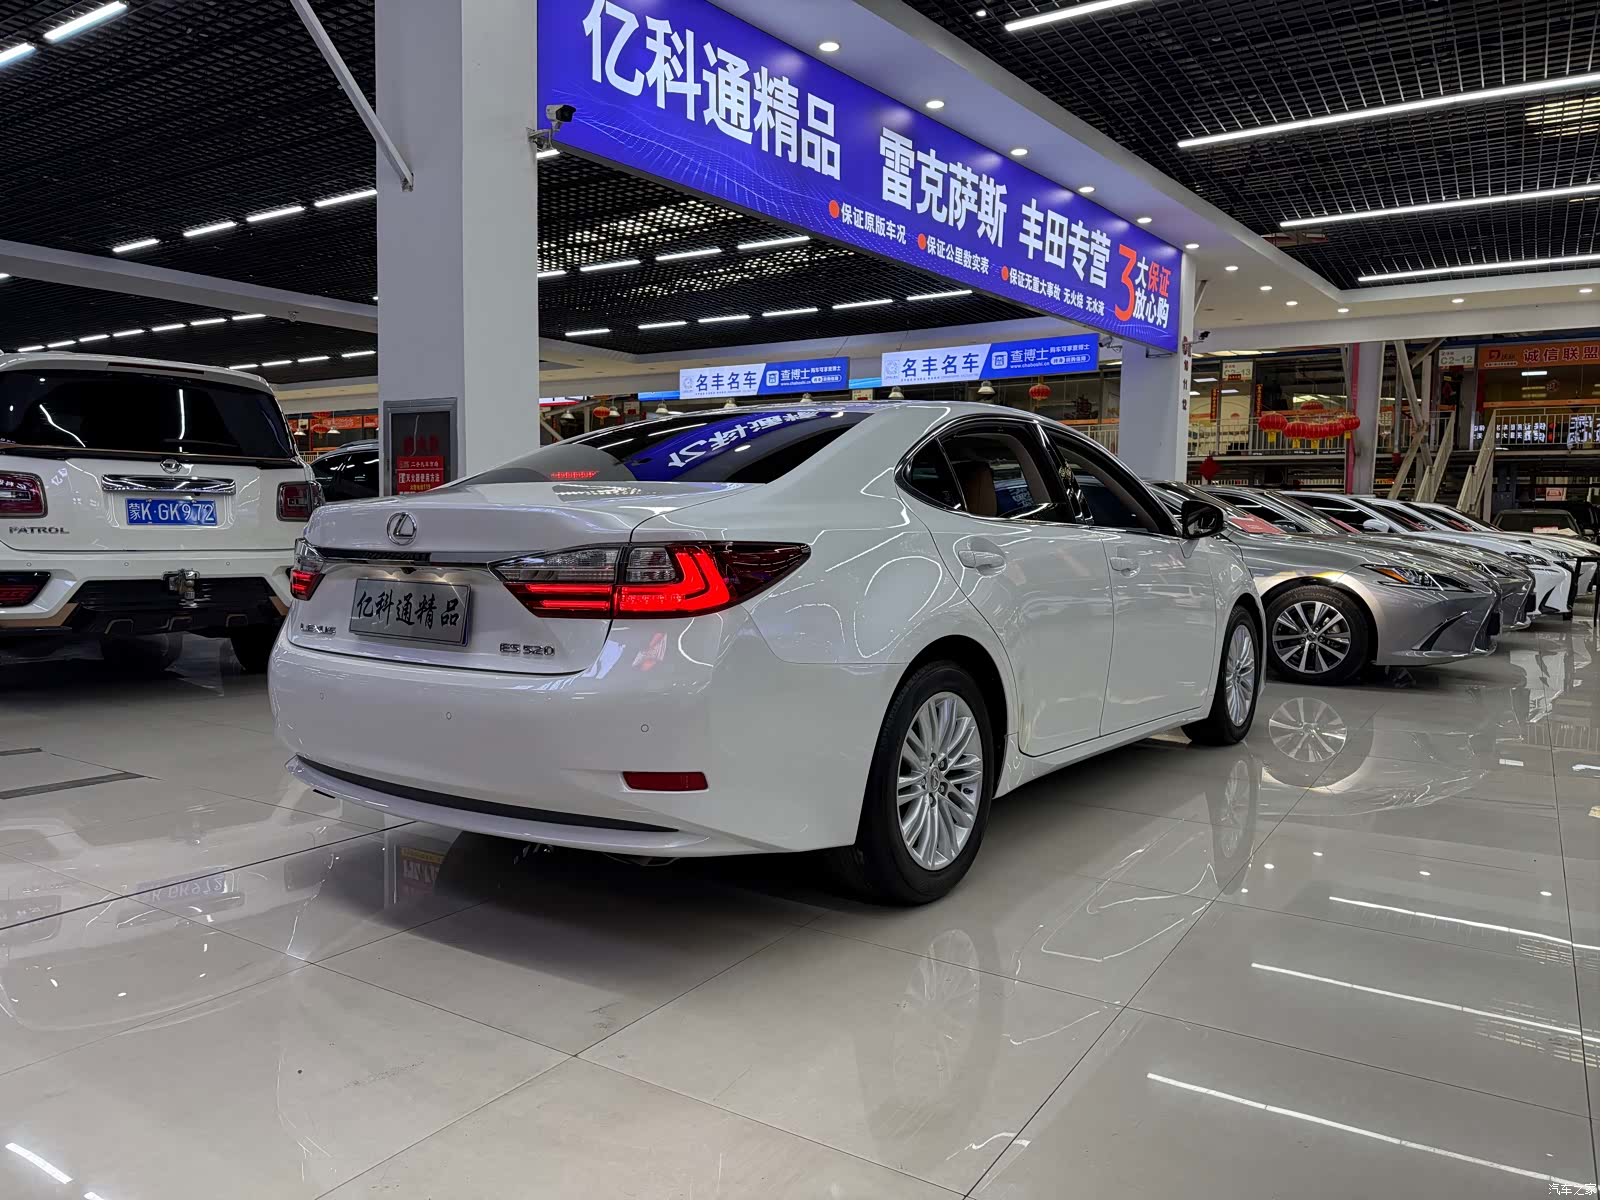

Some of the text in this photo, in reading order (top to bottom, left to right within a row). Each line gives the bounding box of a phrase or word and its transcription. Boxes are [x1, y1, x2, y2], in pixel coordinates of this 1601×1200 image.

[582, 0, 1111, 289] 亿科通精品 雷克萨斯 丰田专营
[841, 201, 907, 245] 保证原版车况
[926, 234, 990, 276] 保证公里数实表
[1009, 267, 1061, 301] 保证无重大事故
[1063, 288, 1084, 309] 无火烧
[1114, 243, 1137, 321] 3
[1132, 288, 1170, 329] 放心购
[901, 353, 980, 378] 名丰名车
[1010, 347, 1049, 363] 查博士
[1440, 355, 1473, 365] C2-12
[1524, 346, 1599, 362] 诚信联盟
[695, 371, 758, 392] 名丰名车
[780, 369, 811, 382] 查博士
[9, 526, 70, 535] PATROL
[356, 589, 461, 630] 亿科通精品
[300, 622, 337, 636] LEXUS
[500, 642, 520, 655] ES
